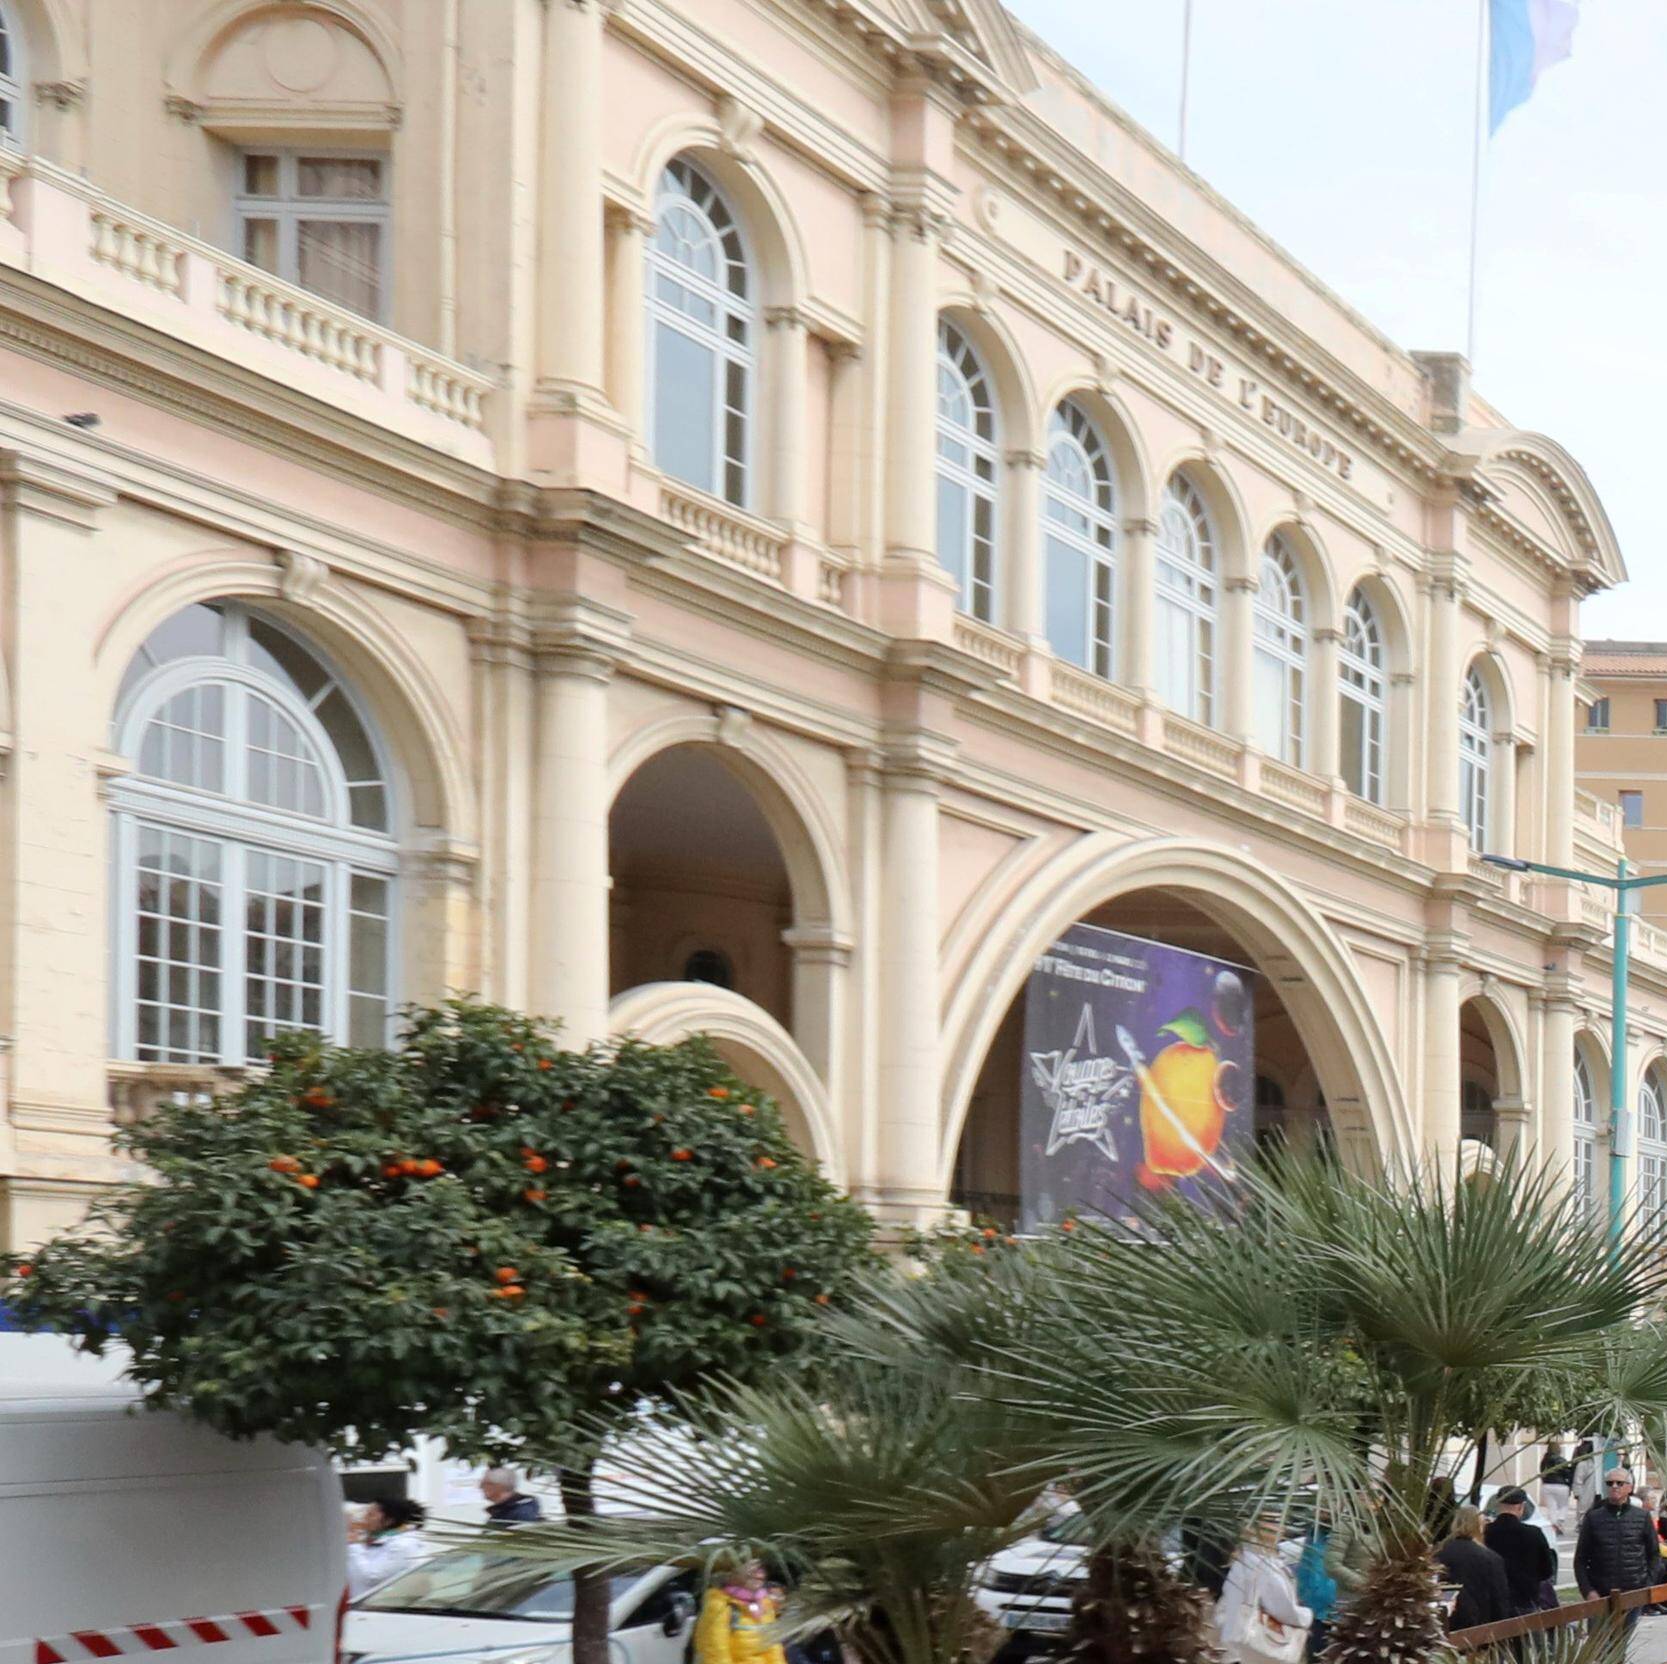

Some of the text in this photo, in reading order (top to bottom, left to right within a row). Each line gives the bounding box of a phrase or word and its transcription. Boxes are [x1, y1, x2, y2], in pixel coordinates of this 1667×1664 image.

[1063, 249, 1352, 480] PALAIS DE L'EUROPE
